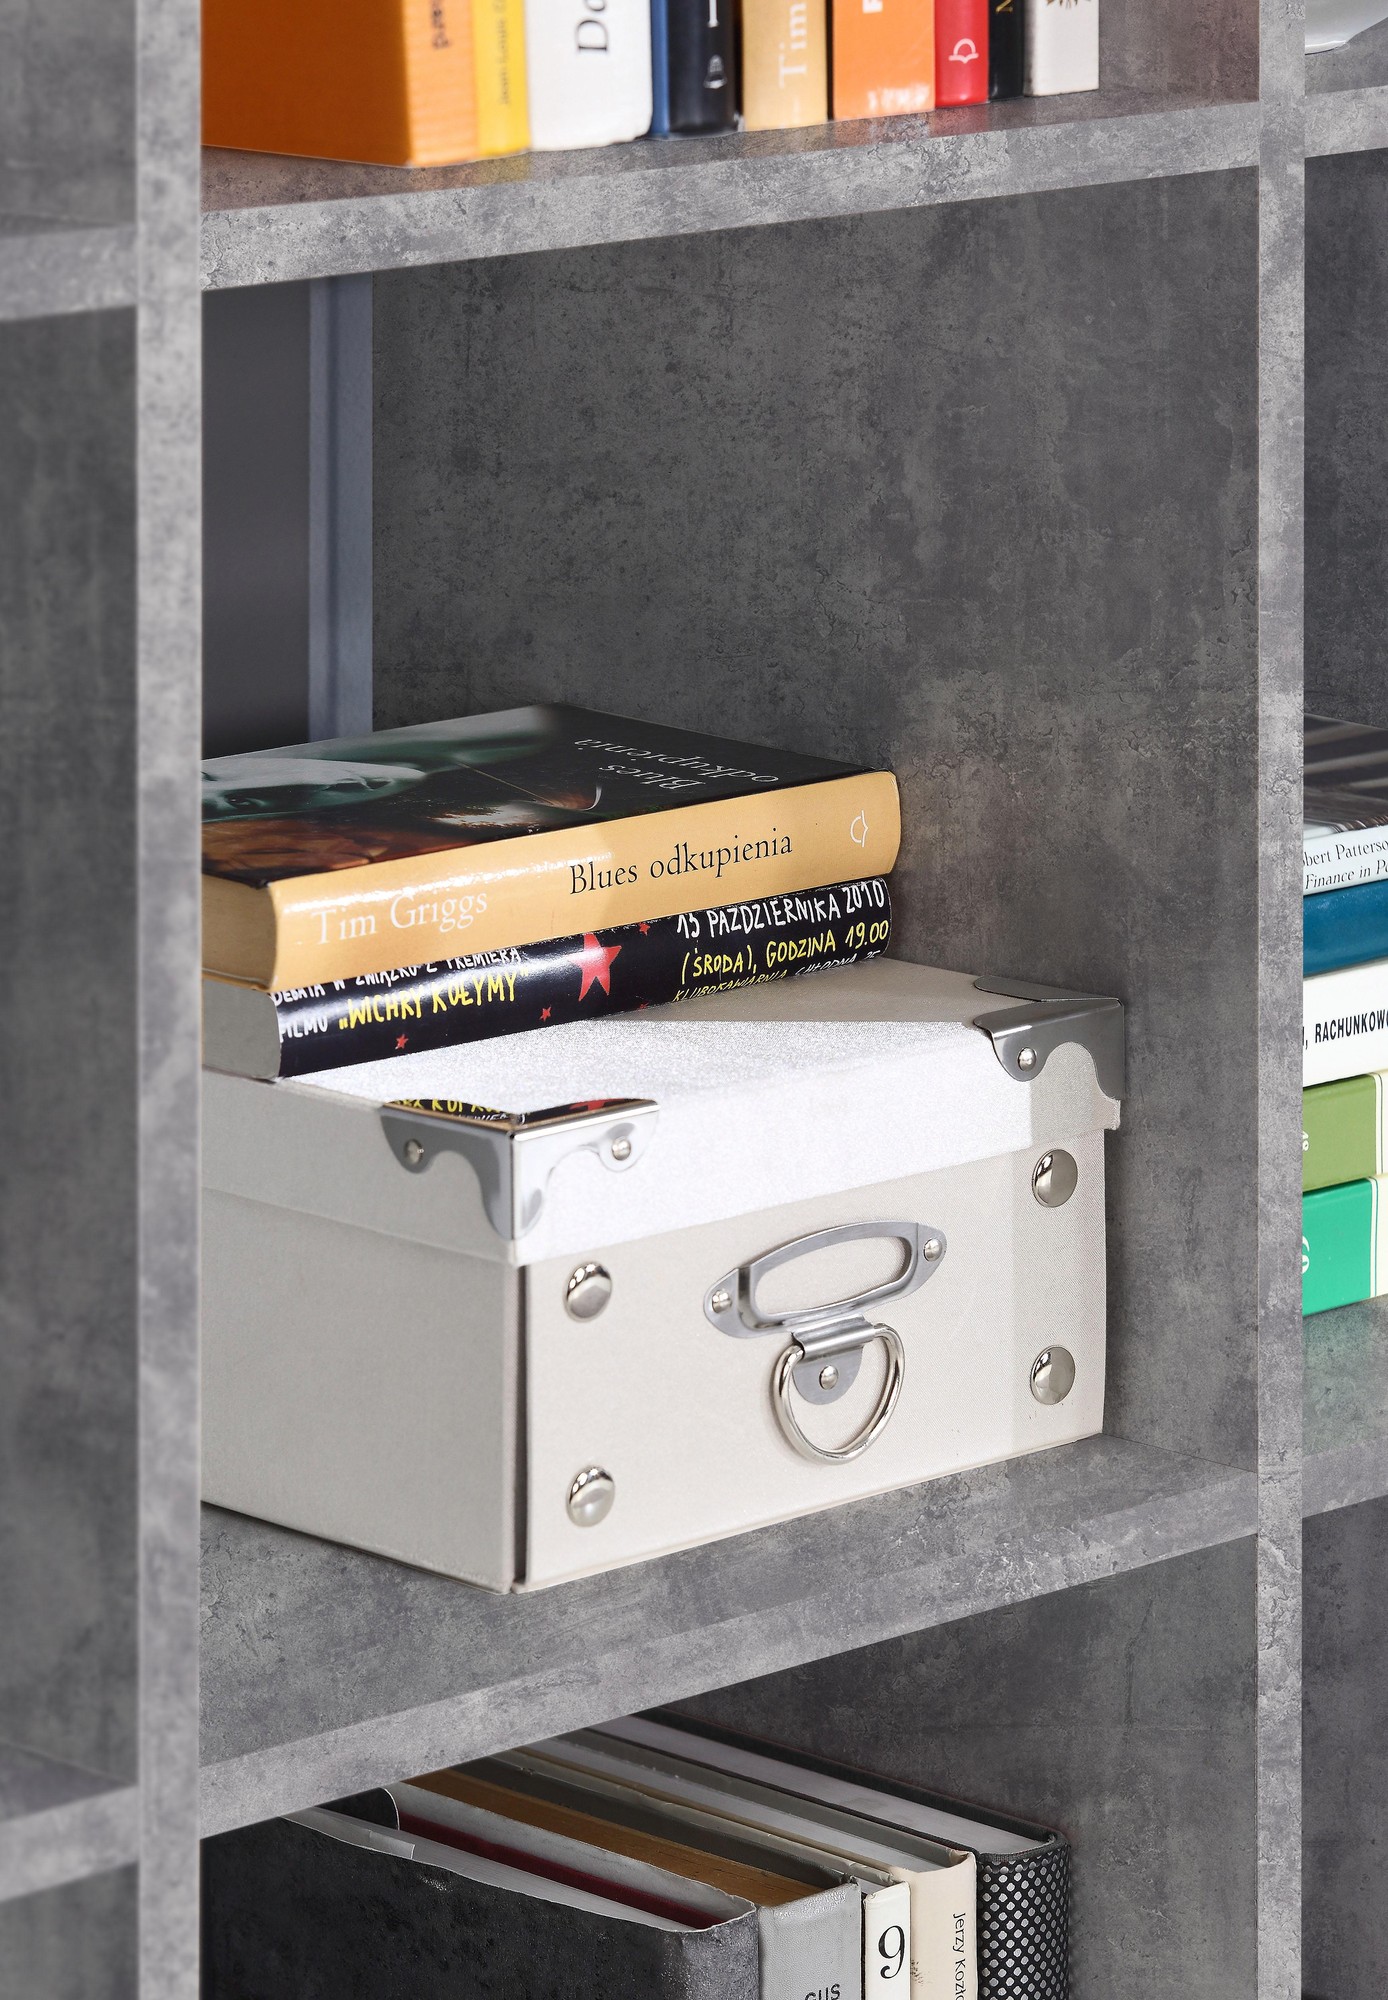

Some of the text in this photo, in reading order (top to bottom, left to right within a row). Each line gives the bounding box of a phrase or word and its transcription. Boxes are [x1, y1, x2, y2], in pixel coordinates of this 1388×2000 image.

[778, 2, 807, 89] Tim
[574, 738, 779, 783] odkupienia
[600, 764, 706, 790] Blues
[569, 827, 793, 894] Blues odkupienia
[1303, 851, 1331, 867] bert
[1305, 870, 1355, 890] Finance
[1359, 865, 1371, 878] in
[311, 891, 488, 945] Tim Griggs
[842, 880, 885, 913] 2010
[766, 929, 836, 968] GODZINA
[844, 919, 889, 949] 19.00
[1315, 1009, 1388, 1043] RACHUNKOW
[877, 1925, 906, 1980] 9
[953, 1912, 966, 1954] Jerzy
